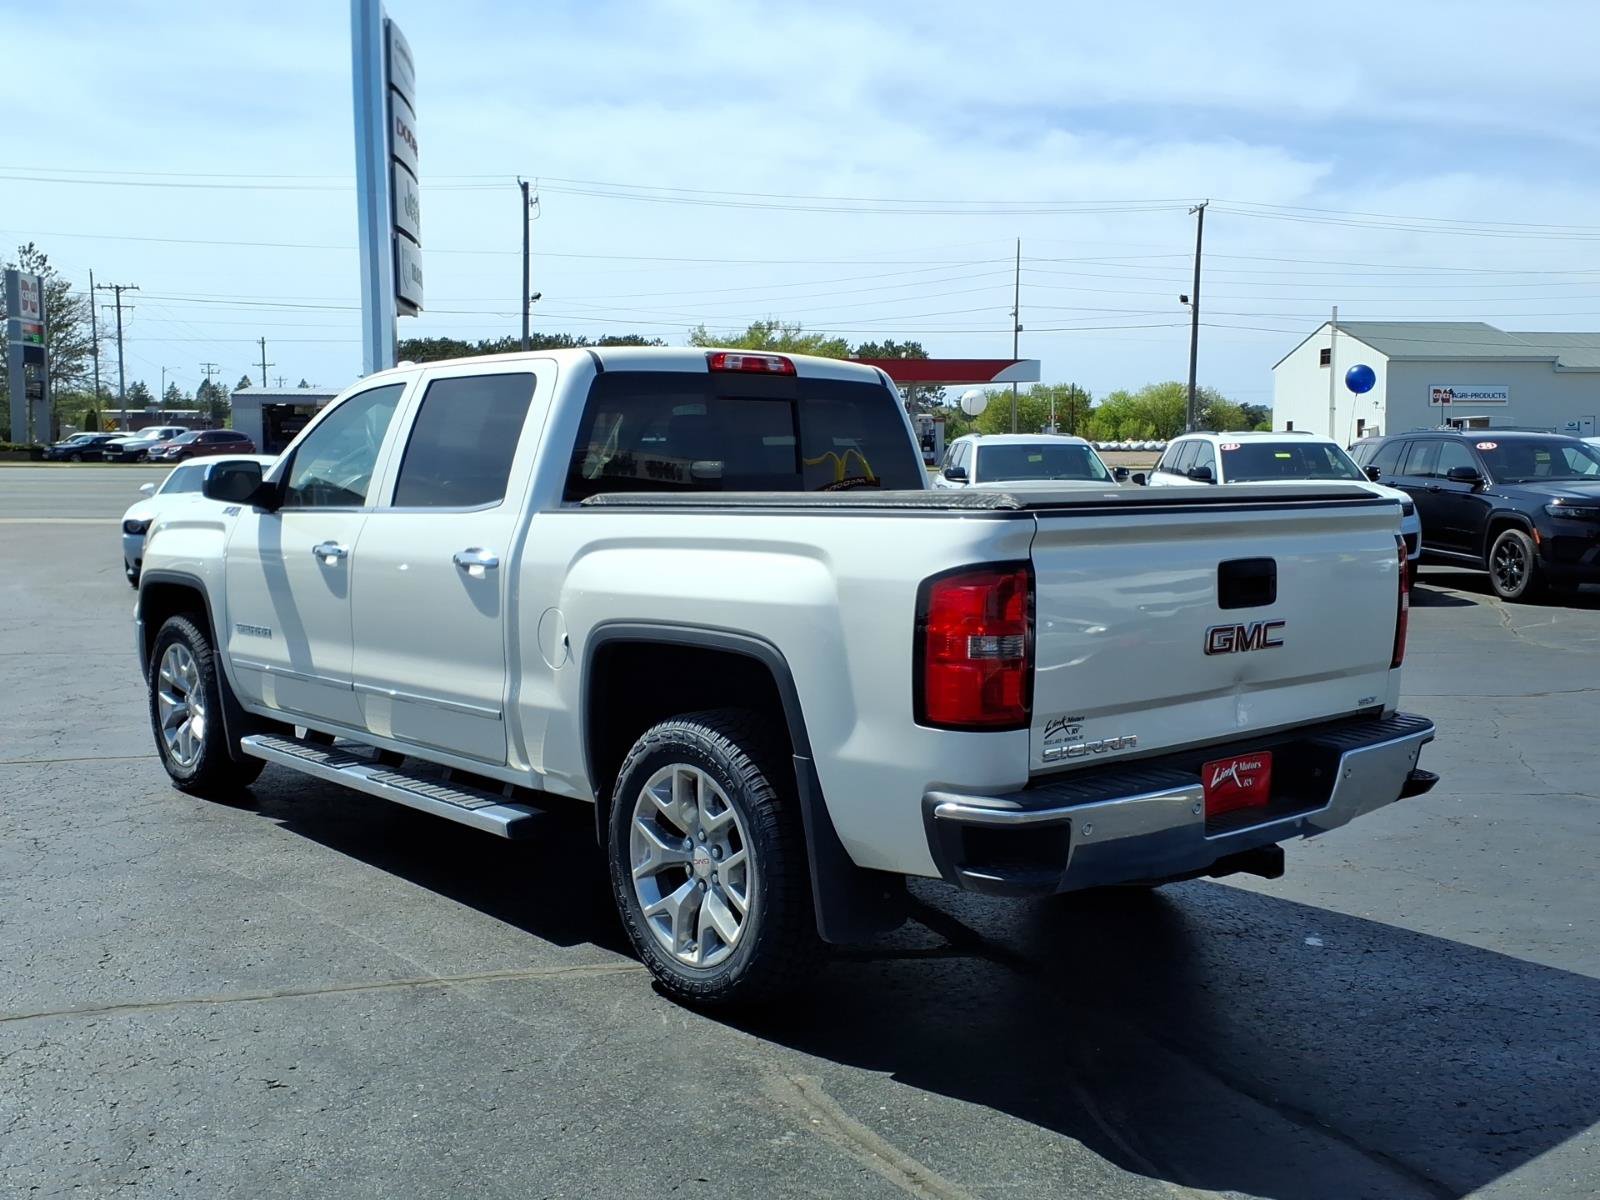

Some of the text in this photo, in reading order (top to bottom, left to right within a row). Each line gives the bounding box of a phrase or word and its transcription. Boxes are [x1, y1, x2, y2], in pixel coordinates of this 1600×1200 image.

[411, 263, 423, 290] RA
[1204, 619, 1286, 656] GMC
[1043, 734, 1138, 763] SIERRA
[1211, 761, 1242, 788] Link
